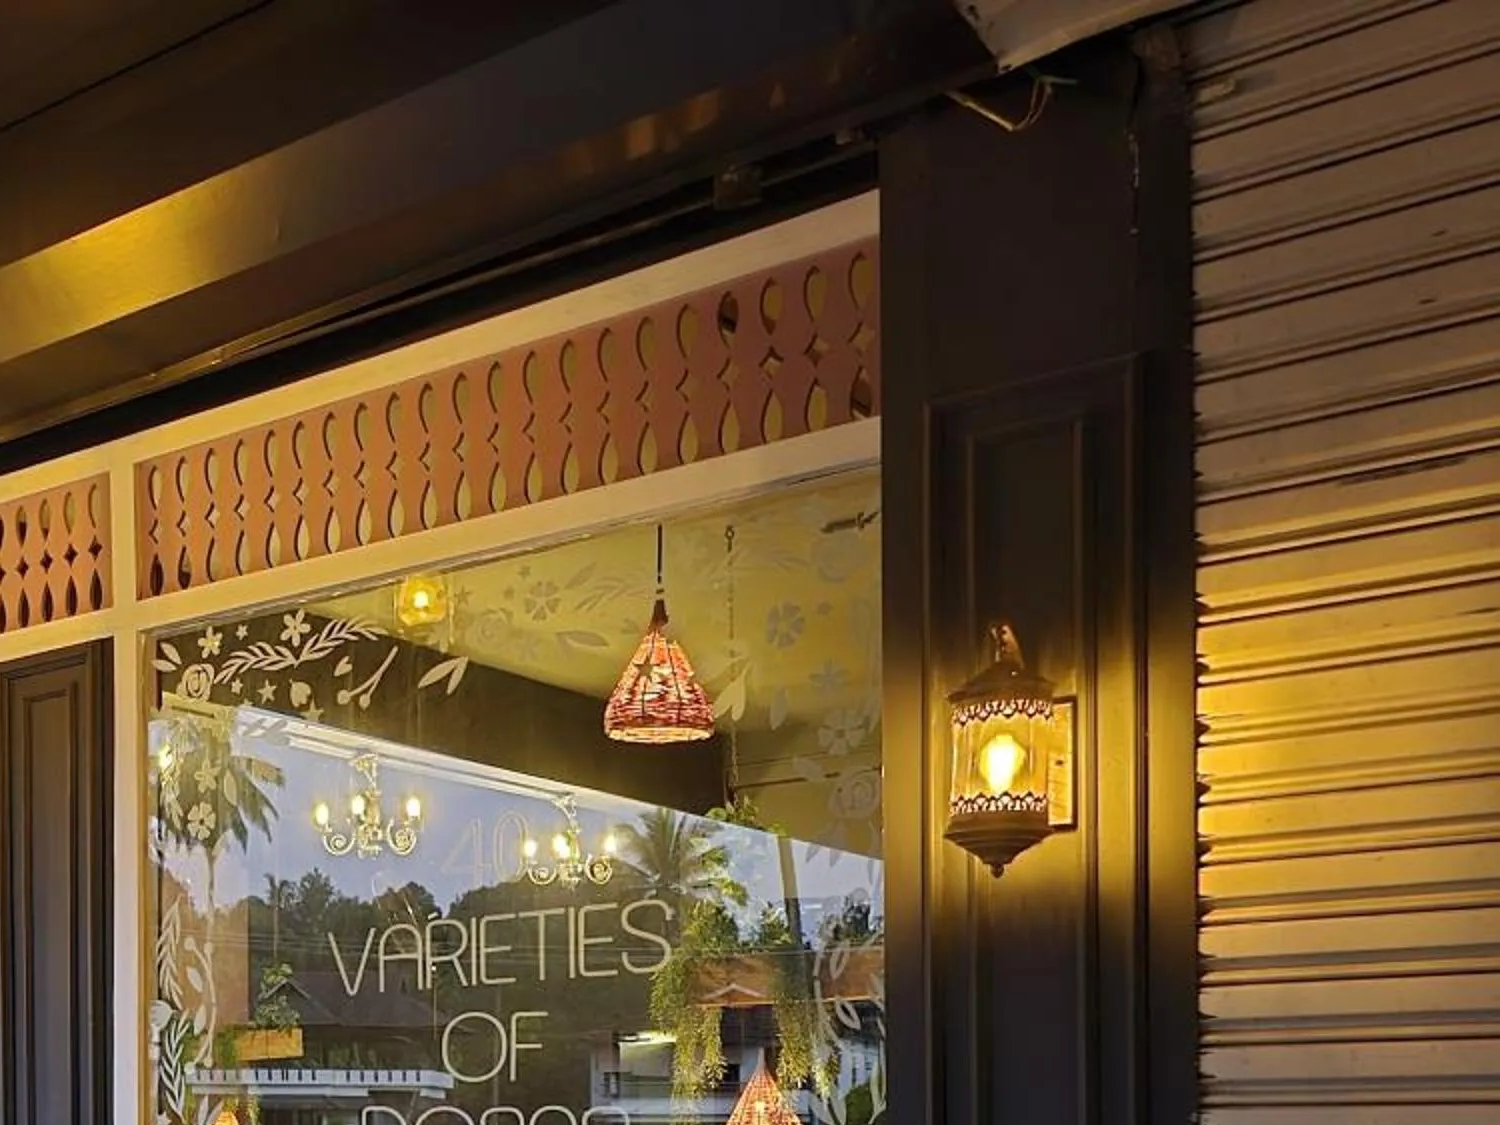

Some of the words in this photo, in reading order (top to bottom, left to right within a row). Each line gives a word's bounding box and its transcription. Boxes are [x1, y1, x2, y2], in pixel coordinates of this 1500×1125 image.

[440, 809, 529, 888] 40
[328, 897, 675, 996] VARIETIES
[441, 1011, 549, 1084] OF
